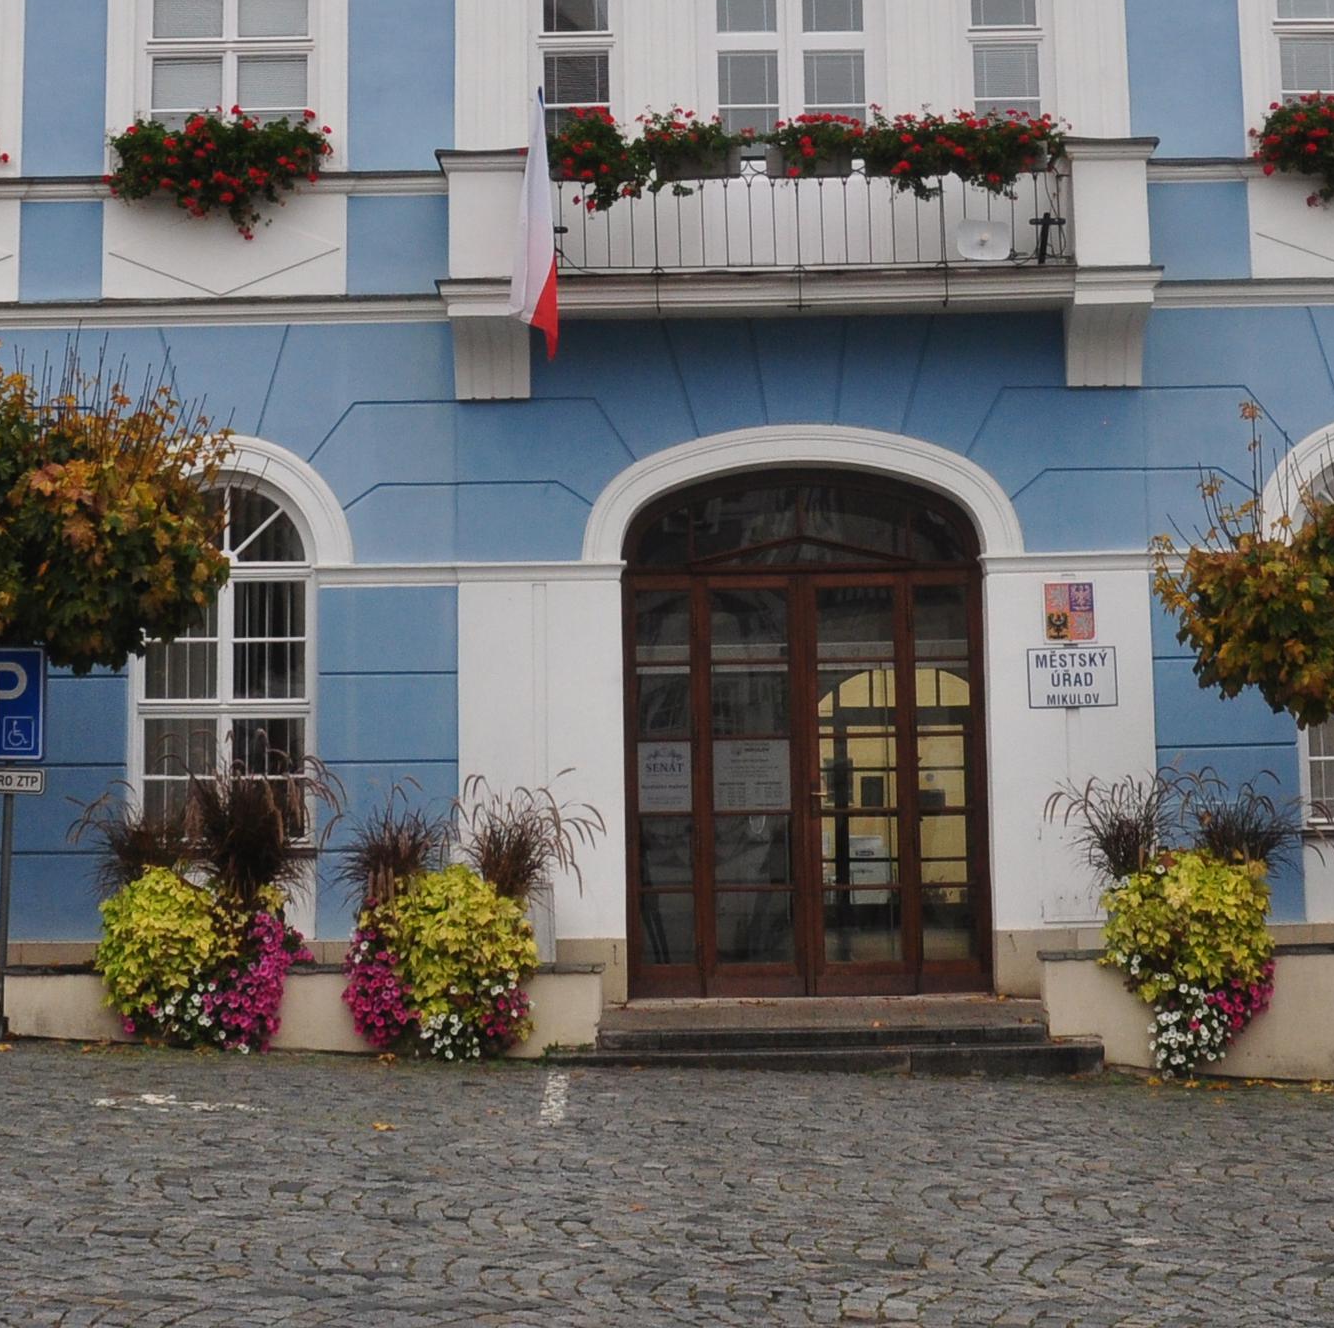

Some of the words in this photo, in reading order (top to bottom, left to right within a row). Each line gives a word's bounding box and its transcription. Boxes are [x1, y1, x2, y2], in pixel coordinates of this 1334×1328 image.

[1035, 649, 1107, 669] MĚSTSKÝ
[1051, 669, 1093, 687] ÚŘAD
[1046, 692, 1100, 706] MIKULOV
[16, 774, 39, 786] ZTP
